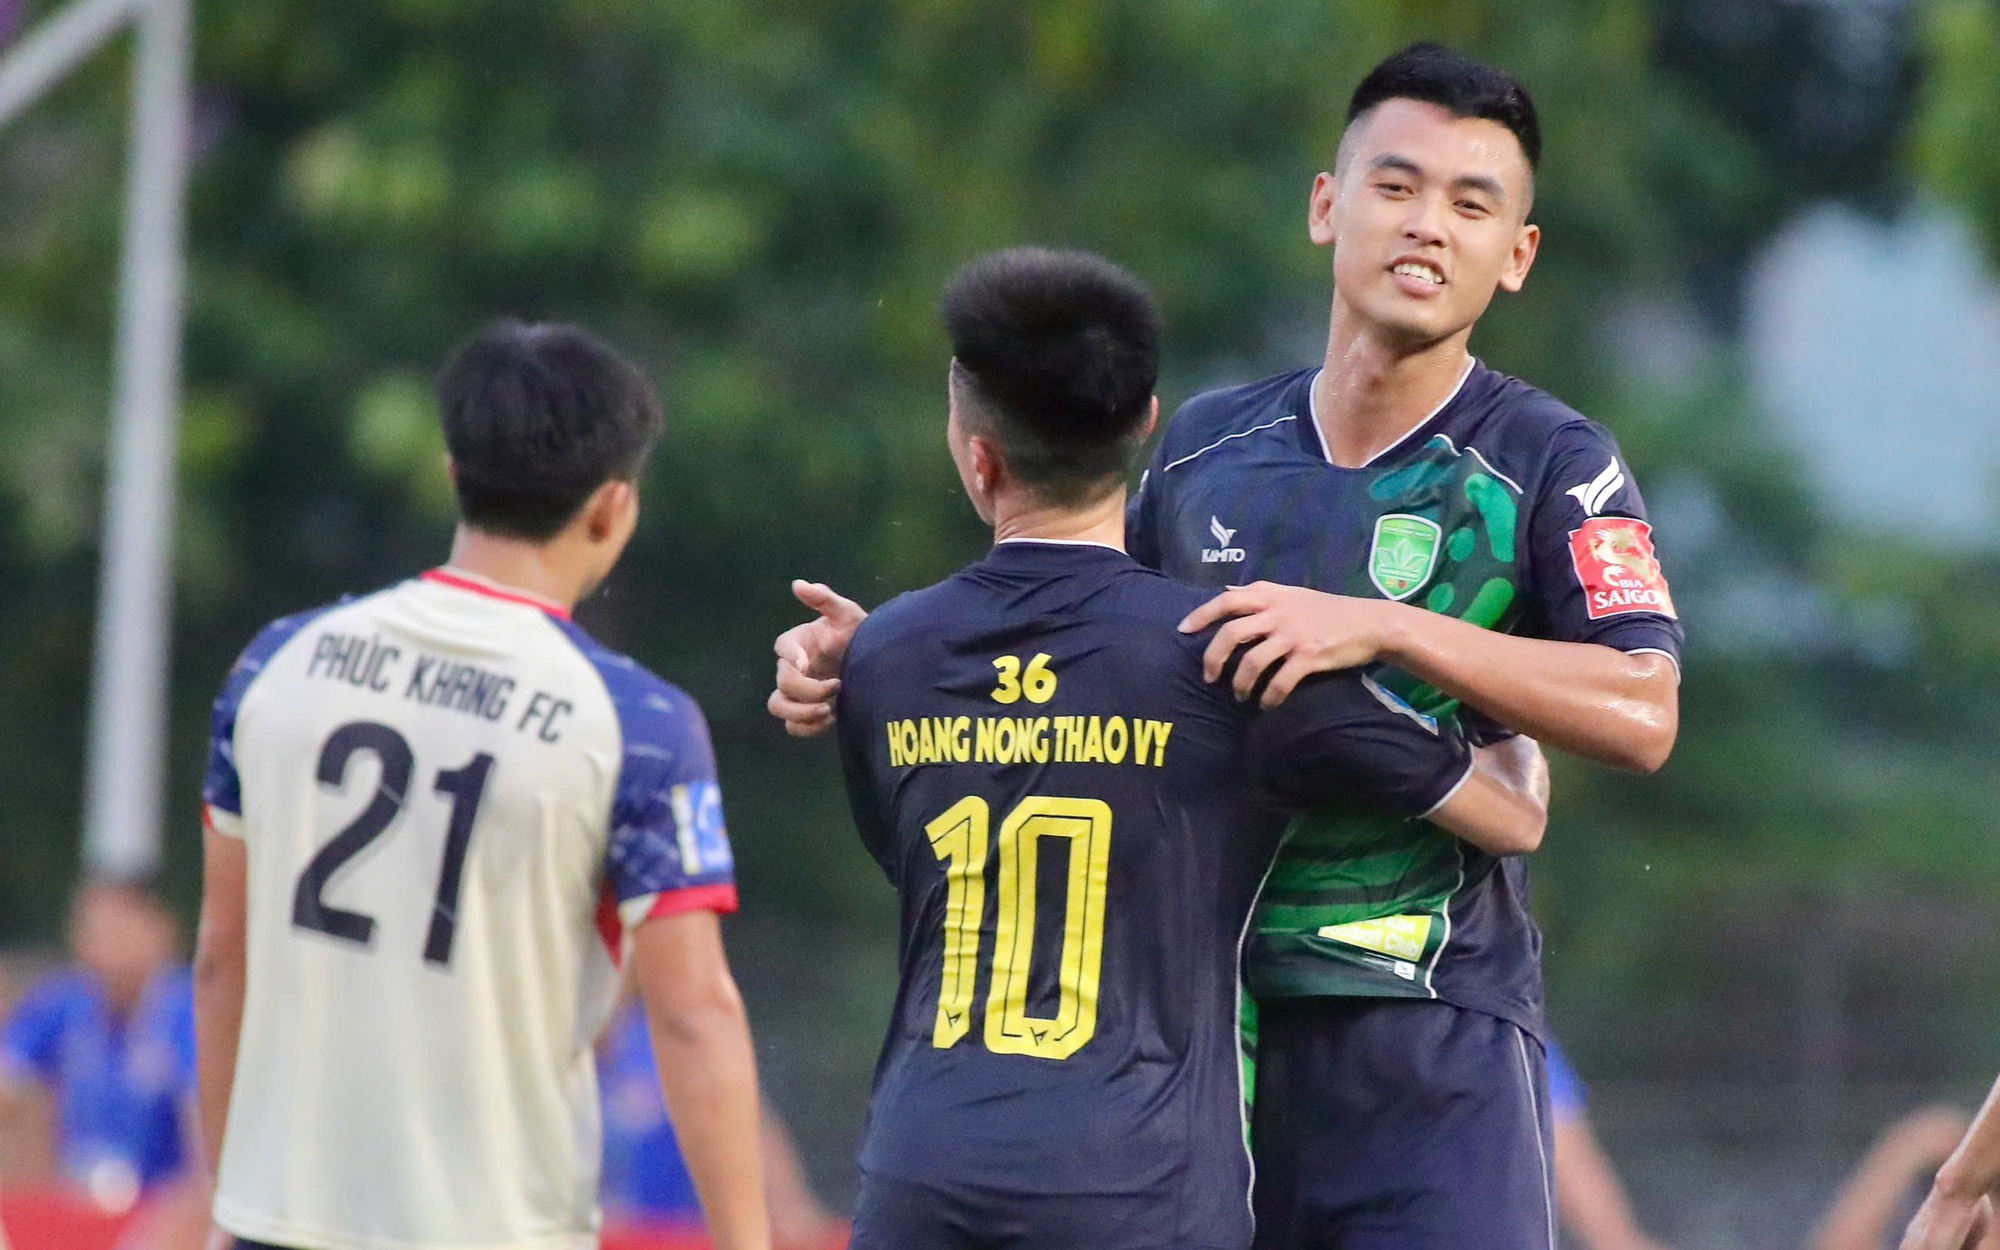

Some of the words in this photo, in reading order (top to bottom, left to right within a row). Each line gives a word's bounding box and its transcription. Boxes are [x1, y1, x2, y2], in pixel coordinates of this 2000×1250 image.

[1201, 548, 1246, 563] KAMITO
[1618, 579, 1645, 588] BIA
[405, 655, 516, 721] KHANG
[517, 690, 573, 743] FC
[990, 652, 1058, 704] 36
[886, 716, 972, 767] HOANG
[974, 716, 1050, 764] NONG
[1053, 715, 1129, 765] THAO
[1133, 718, 1174, 767] VY
[292, 721, 496, 966] 21
[924, 795, 1113, 1060] 10
